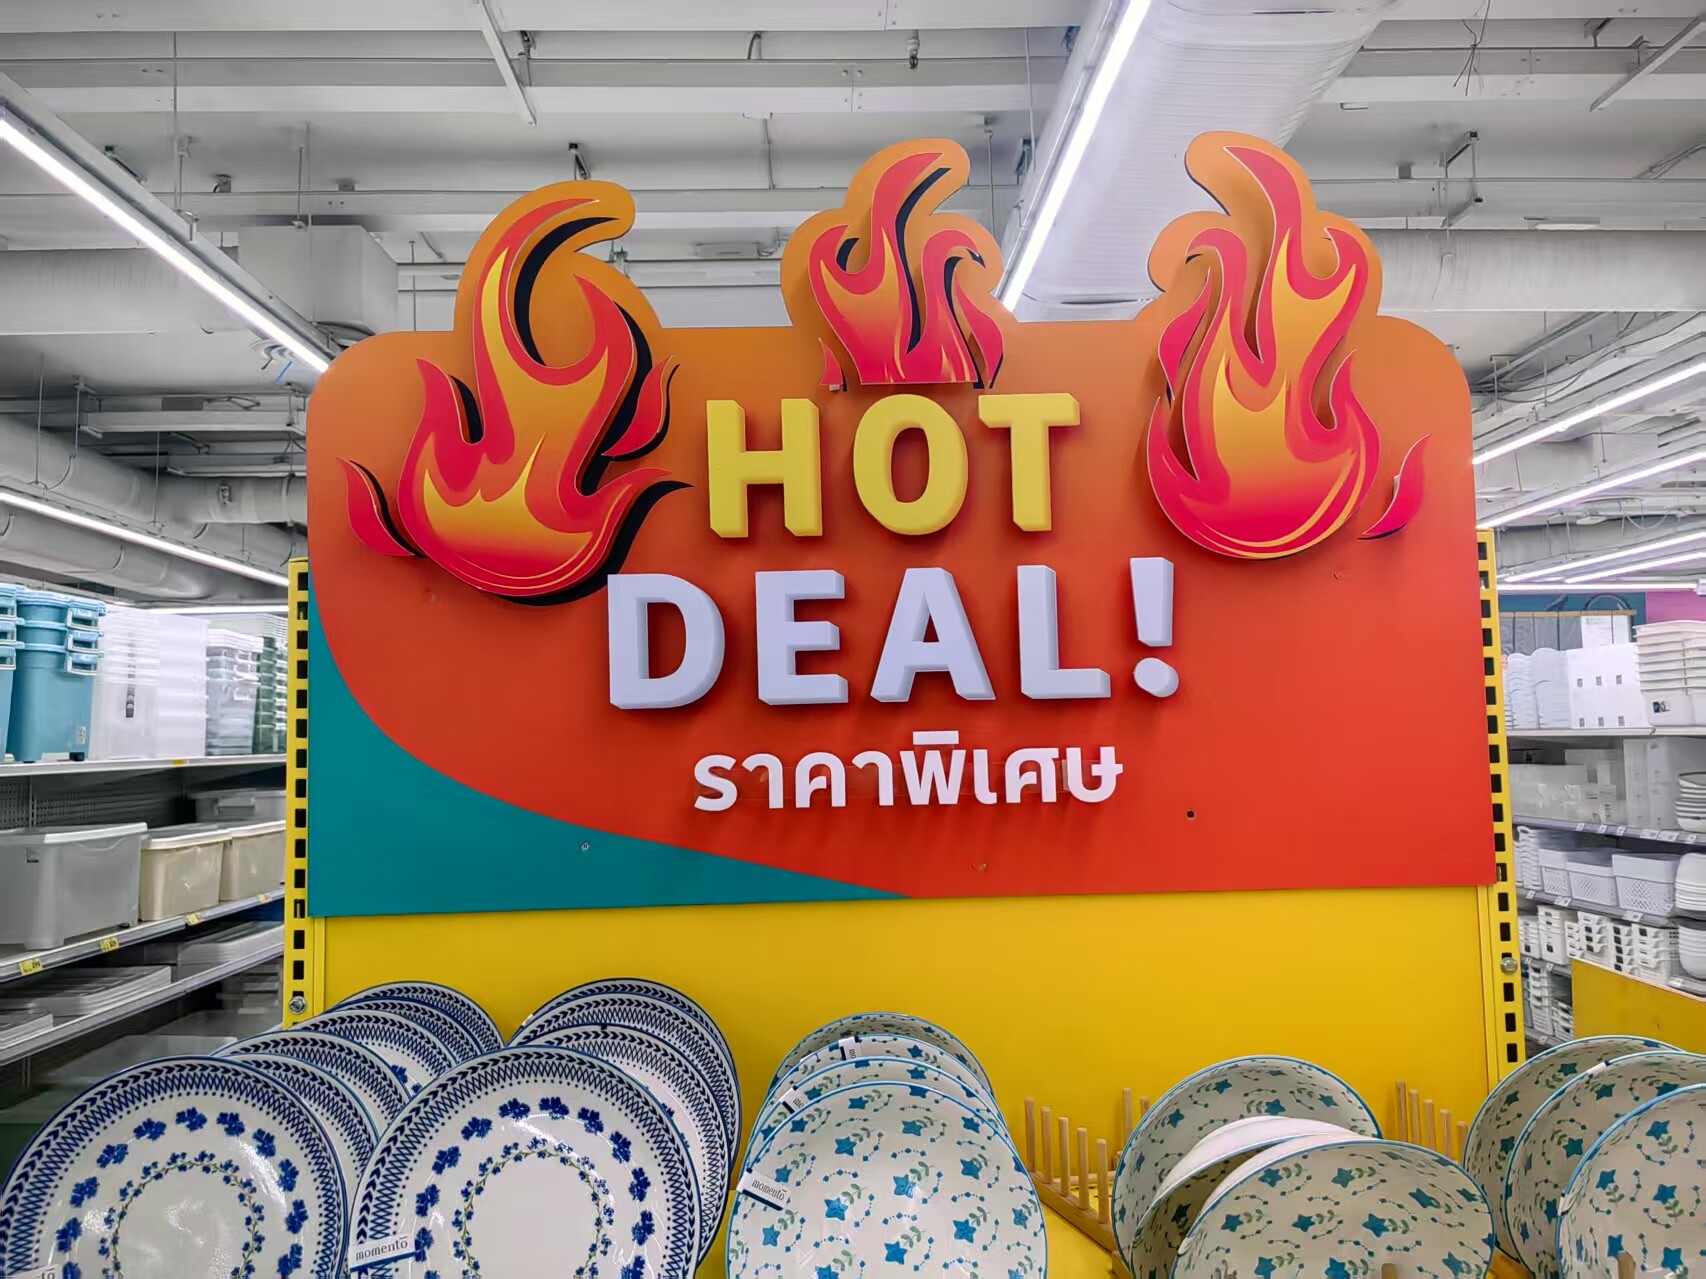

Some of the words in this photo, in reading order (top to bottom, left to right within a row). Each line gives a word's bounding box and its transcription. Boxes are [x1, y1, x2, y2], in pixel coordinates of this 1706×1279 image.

[706, 392, 1080, 538] HOT
[607, 556, 1180, 709] DEAL!
[693, 730, 1123, 811] ราคาพิเศษ
